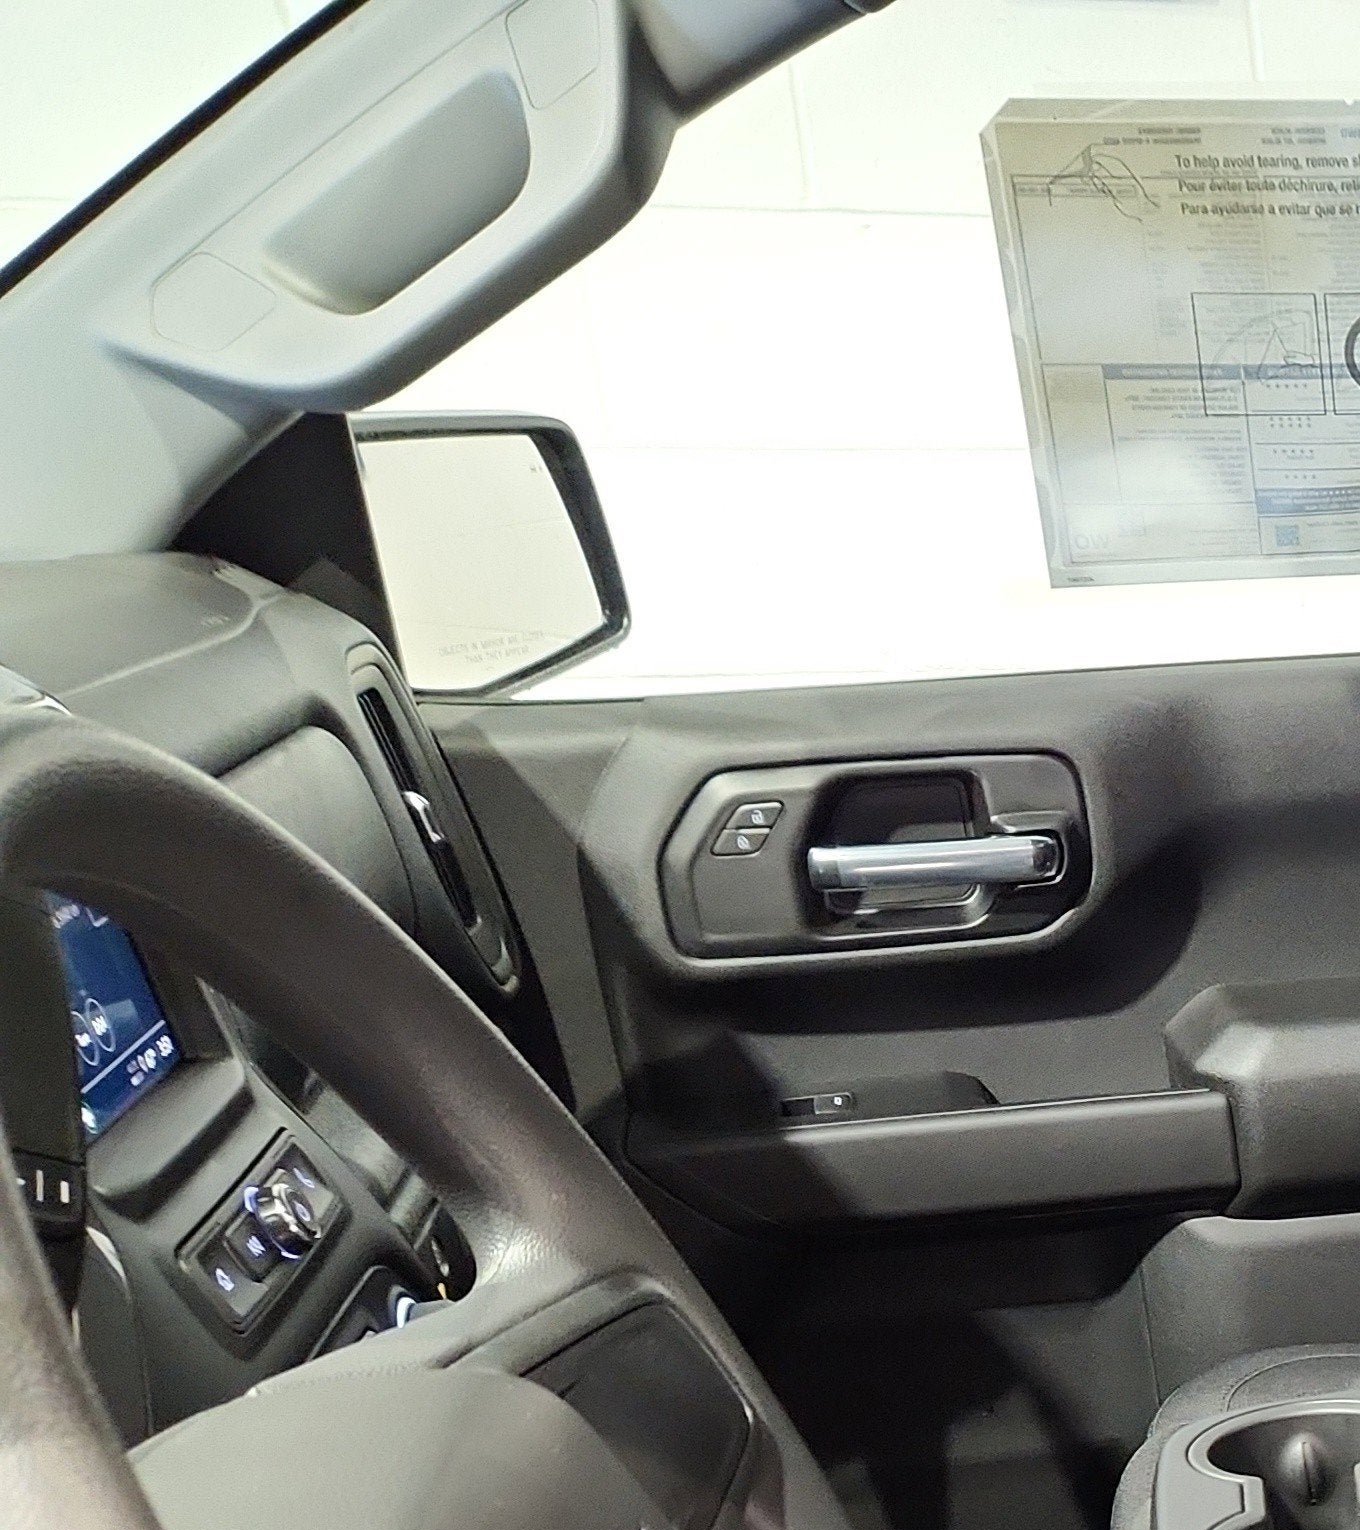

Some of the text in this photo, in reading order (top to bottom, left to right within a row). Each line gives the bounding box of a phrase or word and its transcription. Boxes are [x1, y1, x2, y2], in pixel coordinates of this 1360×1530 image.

[1174, 154, 1190, 168] To
[1193, 154, 1219, 170] help
[1222, 154, 1254, 168] avoid
[1257, 154, 1302, 170] tearing,
[1305, 157, 1348, 168] remove
[1178, 179, 1205, 192] Pour
[1246, 179, 1275, 191] toute
[1181, 202, 1208, 215] Para
[1268, 205, 1275, 214] a
[1278, 203, 1310, 215] evitar
[1314, 205, 1335, 218] que
[1339, 204, 1352, 215] se
